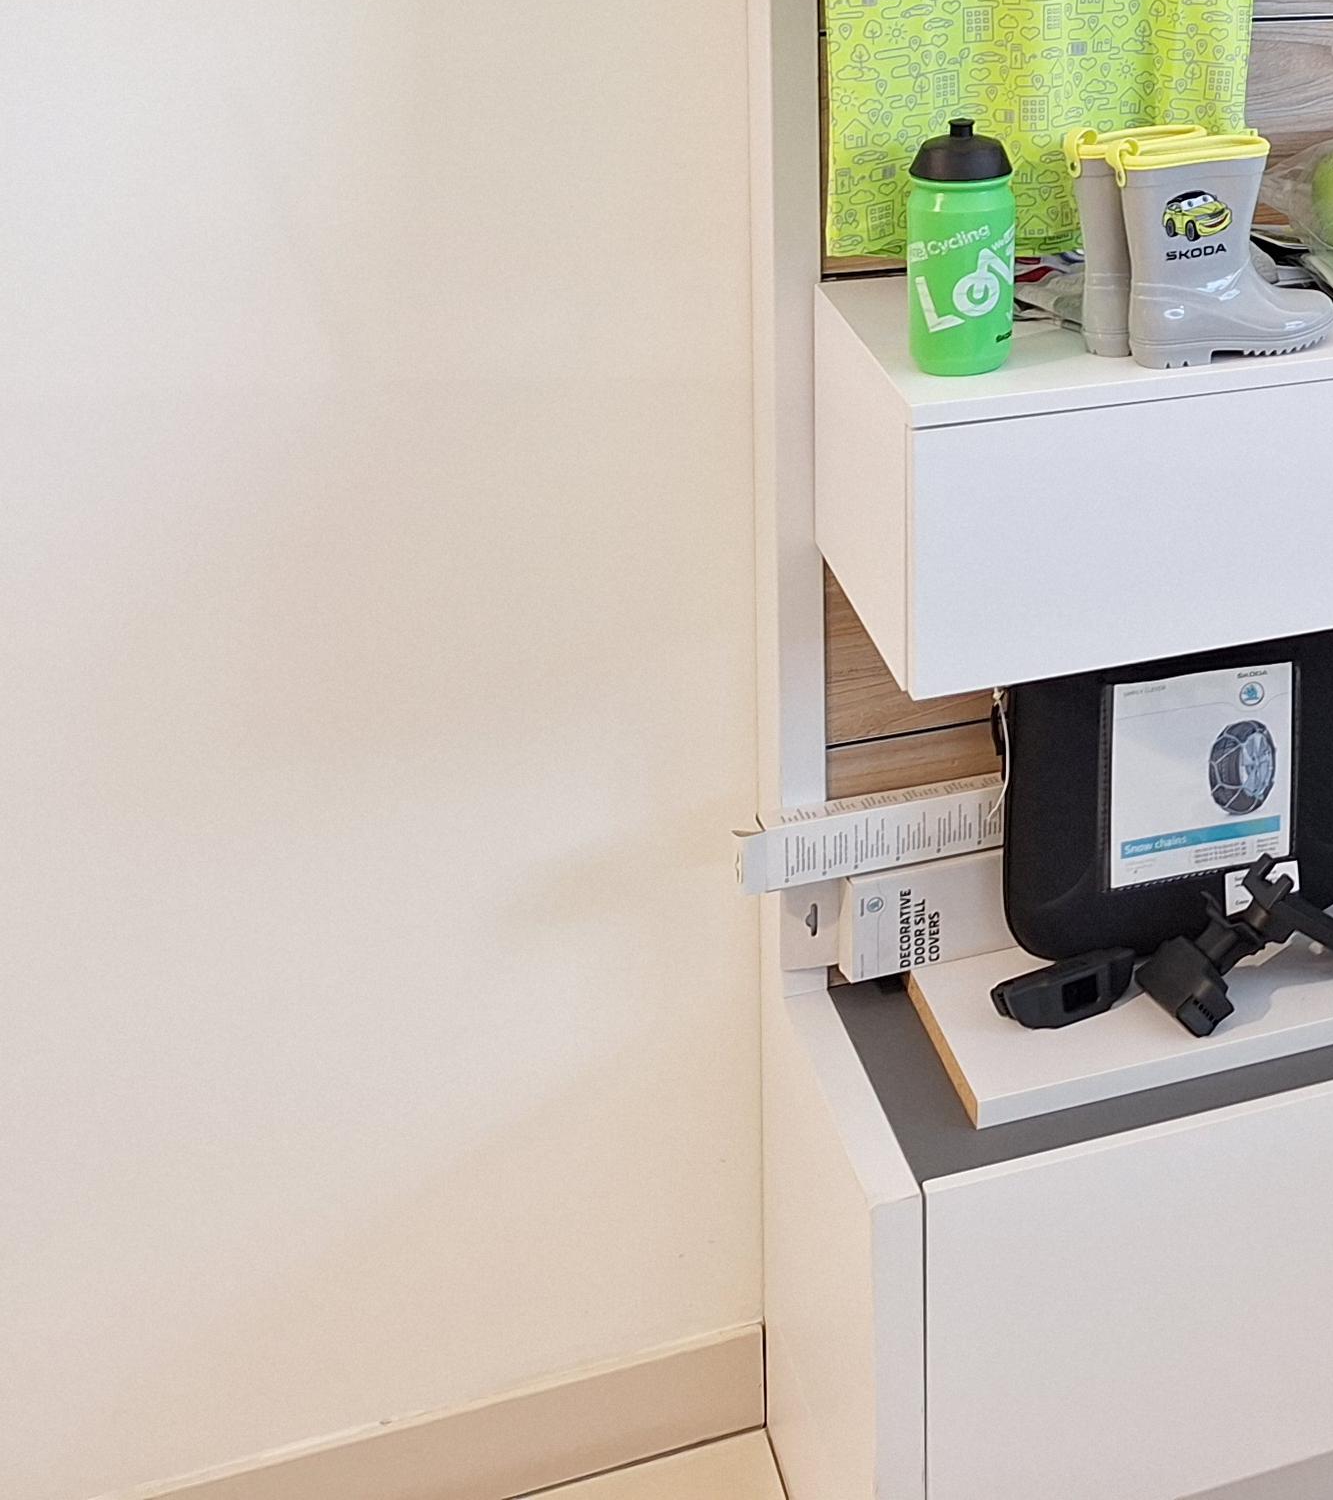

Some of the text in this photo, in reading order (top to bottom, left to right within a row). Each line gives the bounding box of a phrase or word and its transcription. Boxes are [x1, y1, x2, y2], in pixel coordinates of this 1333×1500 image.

[927, 225, 991, 255] Cycling
[1123, 834, 1187, 855] Snow chains
[899, 888, 912, 969] DECORATIVE
[914, 898, 926, 966] DOOR SILL
[928, 911, 940, 963] COVERS
